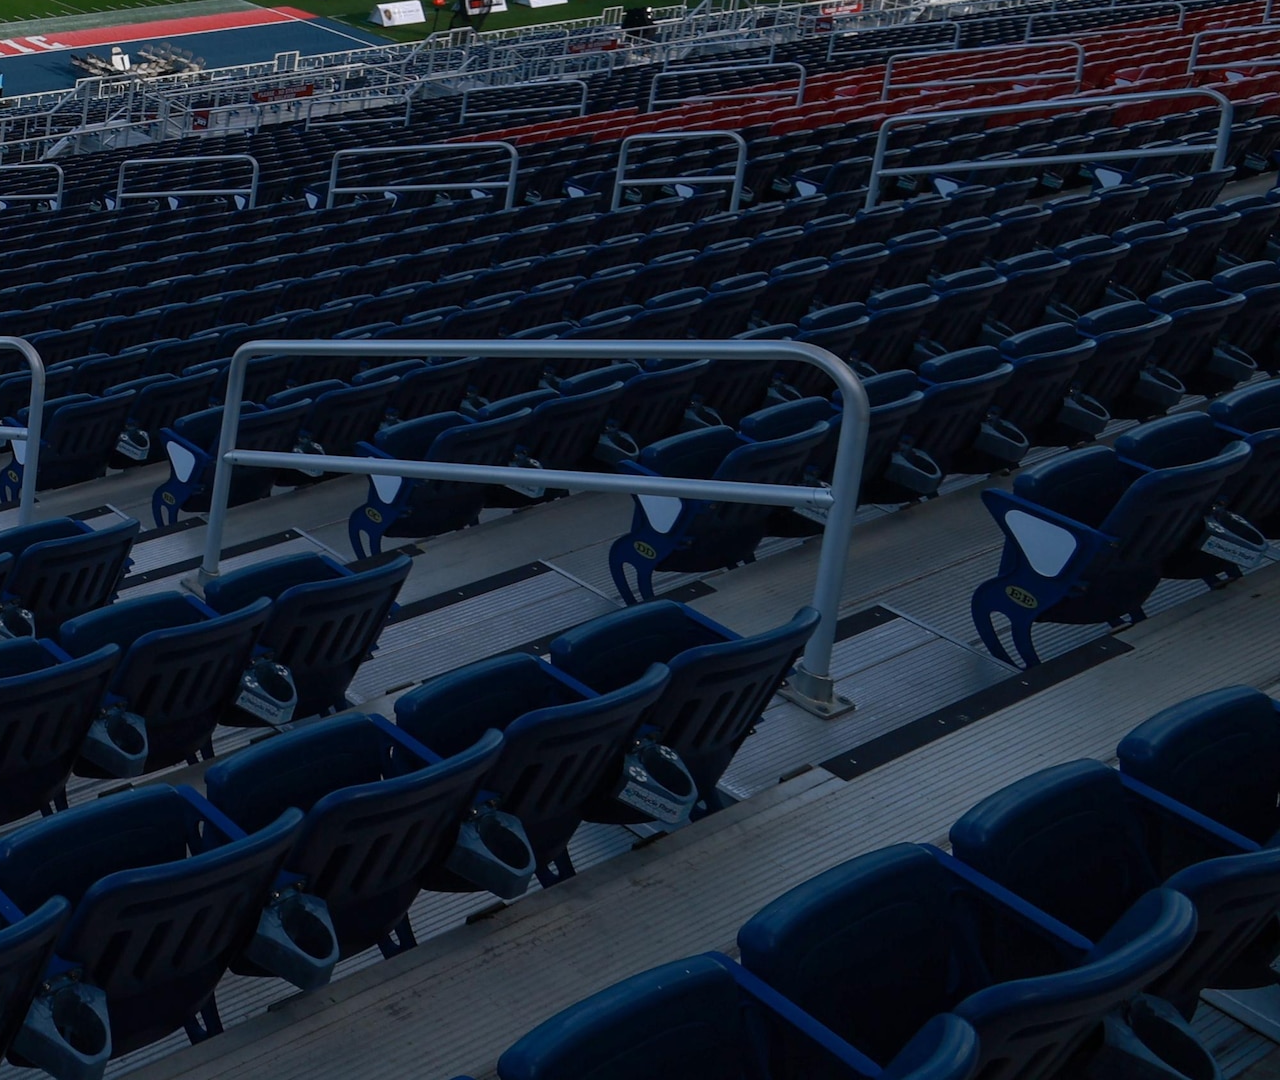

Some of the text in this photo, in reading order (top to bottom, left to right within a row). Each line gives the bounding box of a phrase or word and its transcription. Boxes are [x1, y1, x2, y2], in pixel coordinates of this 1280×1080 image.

[367, 509, 380, 521] CC
[637, 543, 654, 556] DD
[1010, 588, 1034, 604] EE
[632, 790, 679, 816] Recycle Right
